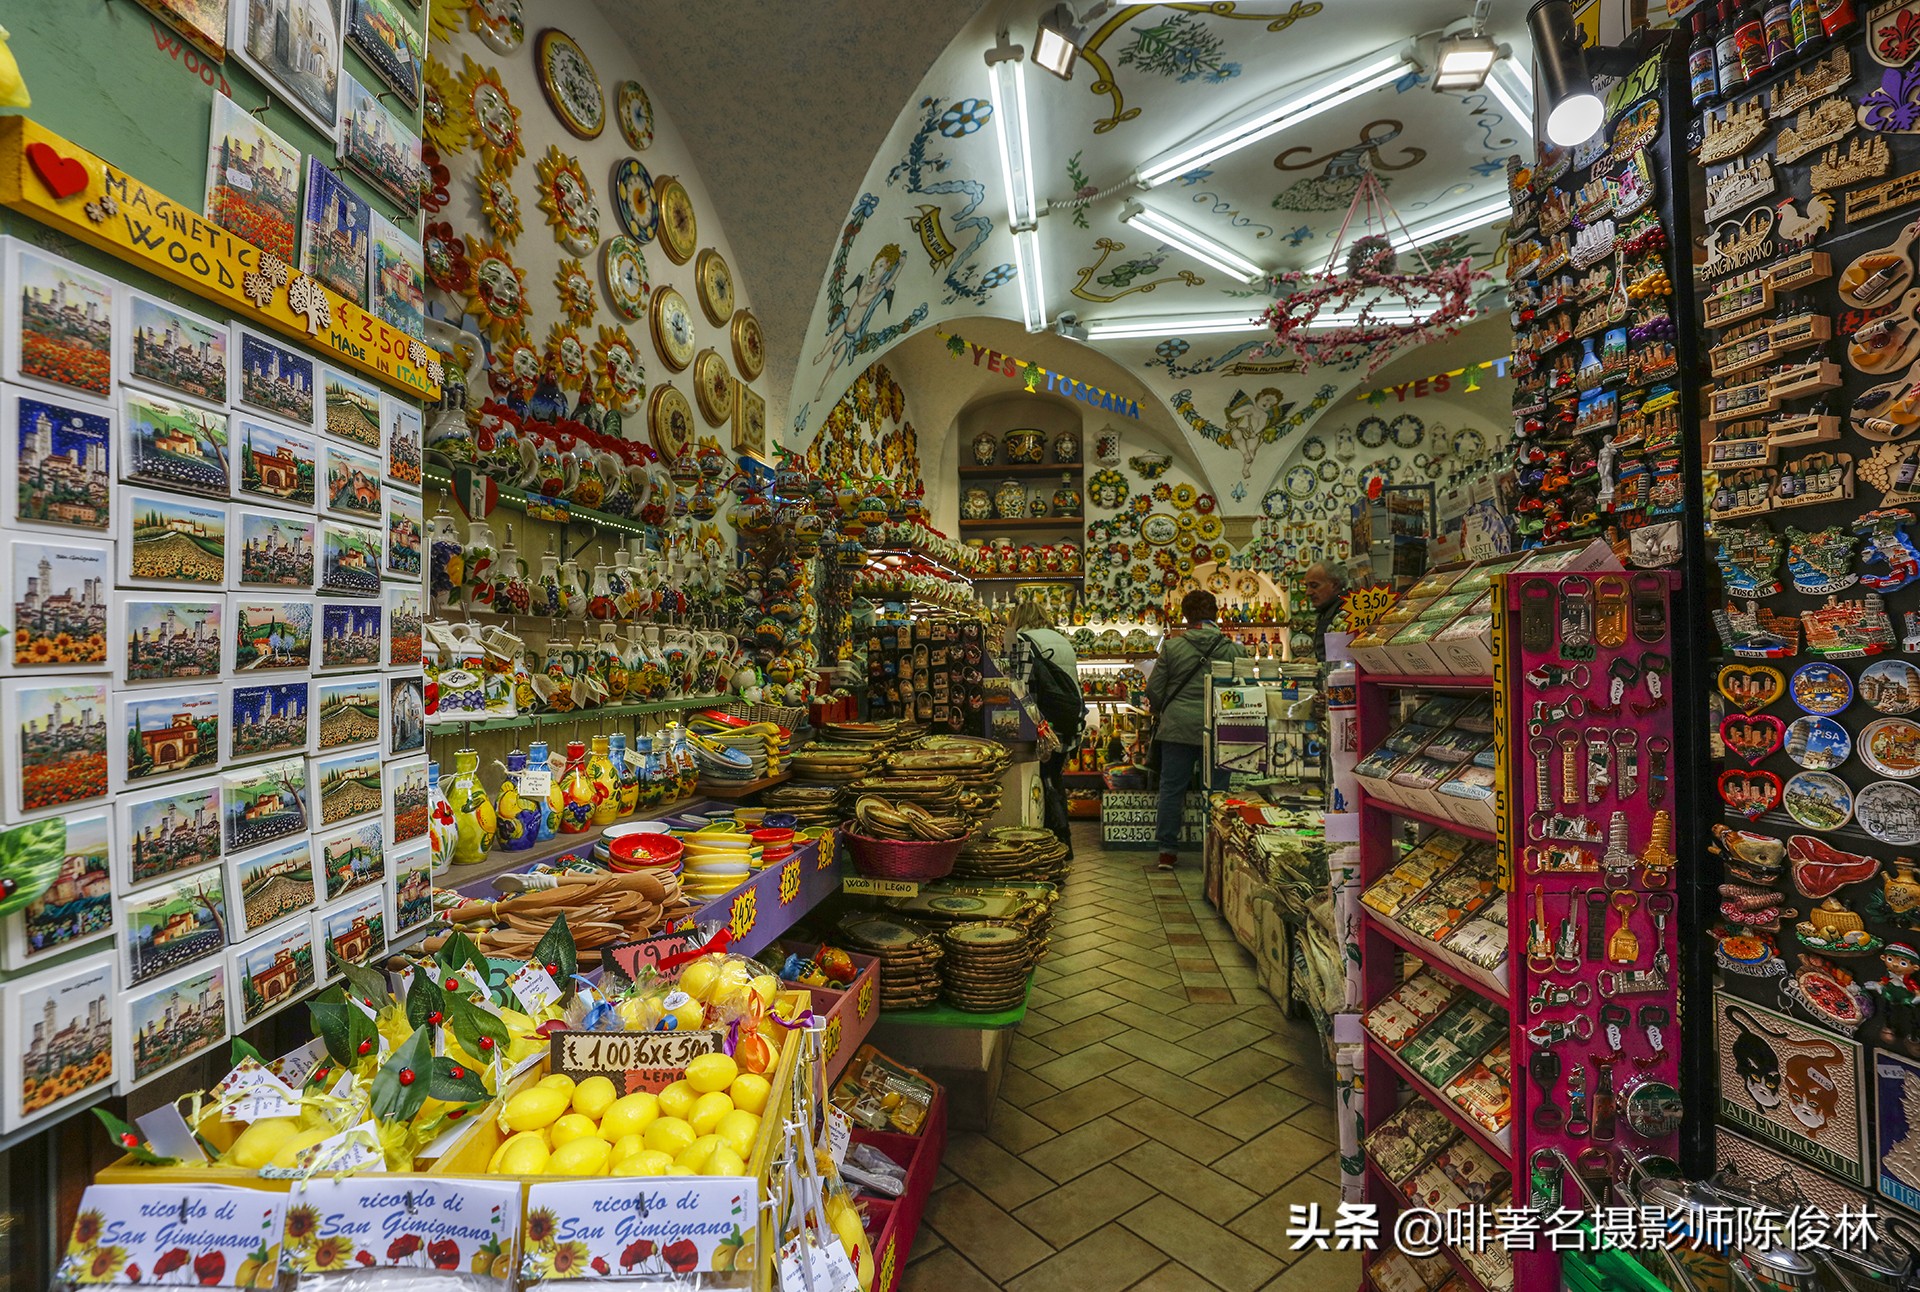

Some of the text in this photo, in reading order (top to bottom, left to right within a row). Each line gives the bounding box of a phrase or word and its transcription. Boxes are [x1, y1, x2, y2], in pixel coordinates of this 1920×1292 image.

[151, 21, 232, 98] WOOD
[1708, 131, 1756, 160] TOSCANA
[1806, 136, 1835, 153] ITALIA
[103, 167, 252, 268] MAGNETIC
[923, 216, 937, 242] TEMPUS
[124, 212, 235, 290] WOOD
[930, 239, 947, 257] VOLAT
[331, 331, 432, 393] MADE IN ITALY
[970, 343, 1140, 420] YES TOSCANA
[1392, 373, 1452, 402] YES
[1738, 505, 1763, 514] TOSCANA
[1780, 498, 1796, 506] VINI
[1804, 491, 1834, 503] TOSCANA
[1885, 496, 1900, 504] VINI
[1732, 586, 1773, 598] TOSCANA
[1800, 580, 1851, 594] TOSCANA
[1738, 650, 1764, 658] ITALIA
[1490, 583, 1504, 766] TUSCANY
[1613, 680, 1621, 701] ITALIA
[1816, 730, 1840, 741] PISA
[1496, 790, 1508, 879] SOAP
[845, 879, 870, 888] WOOD
[885, 883, 912, 893] LEGNO
[1610, 1026, 1620, 1049] ITALIA
[1650, 1027, 1660, 1049] ITALIA
[1474, 1084, 1501, 1106] FRUTTETO
[1725, 1102, 1858, 1179] ATTENTI AI GATTI
[214, 1200, 238, 1221] di
[443, 1192, 464, 1213] di
[676, 1189, 700, 1210] di
[319, 1210, 493, 1241] San Gimignano
[557, 1214, 732, 1246] San Gimignano
[101, 1221, 262, 1253] San Gimignano
